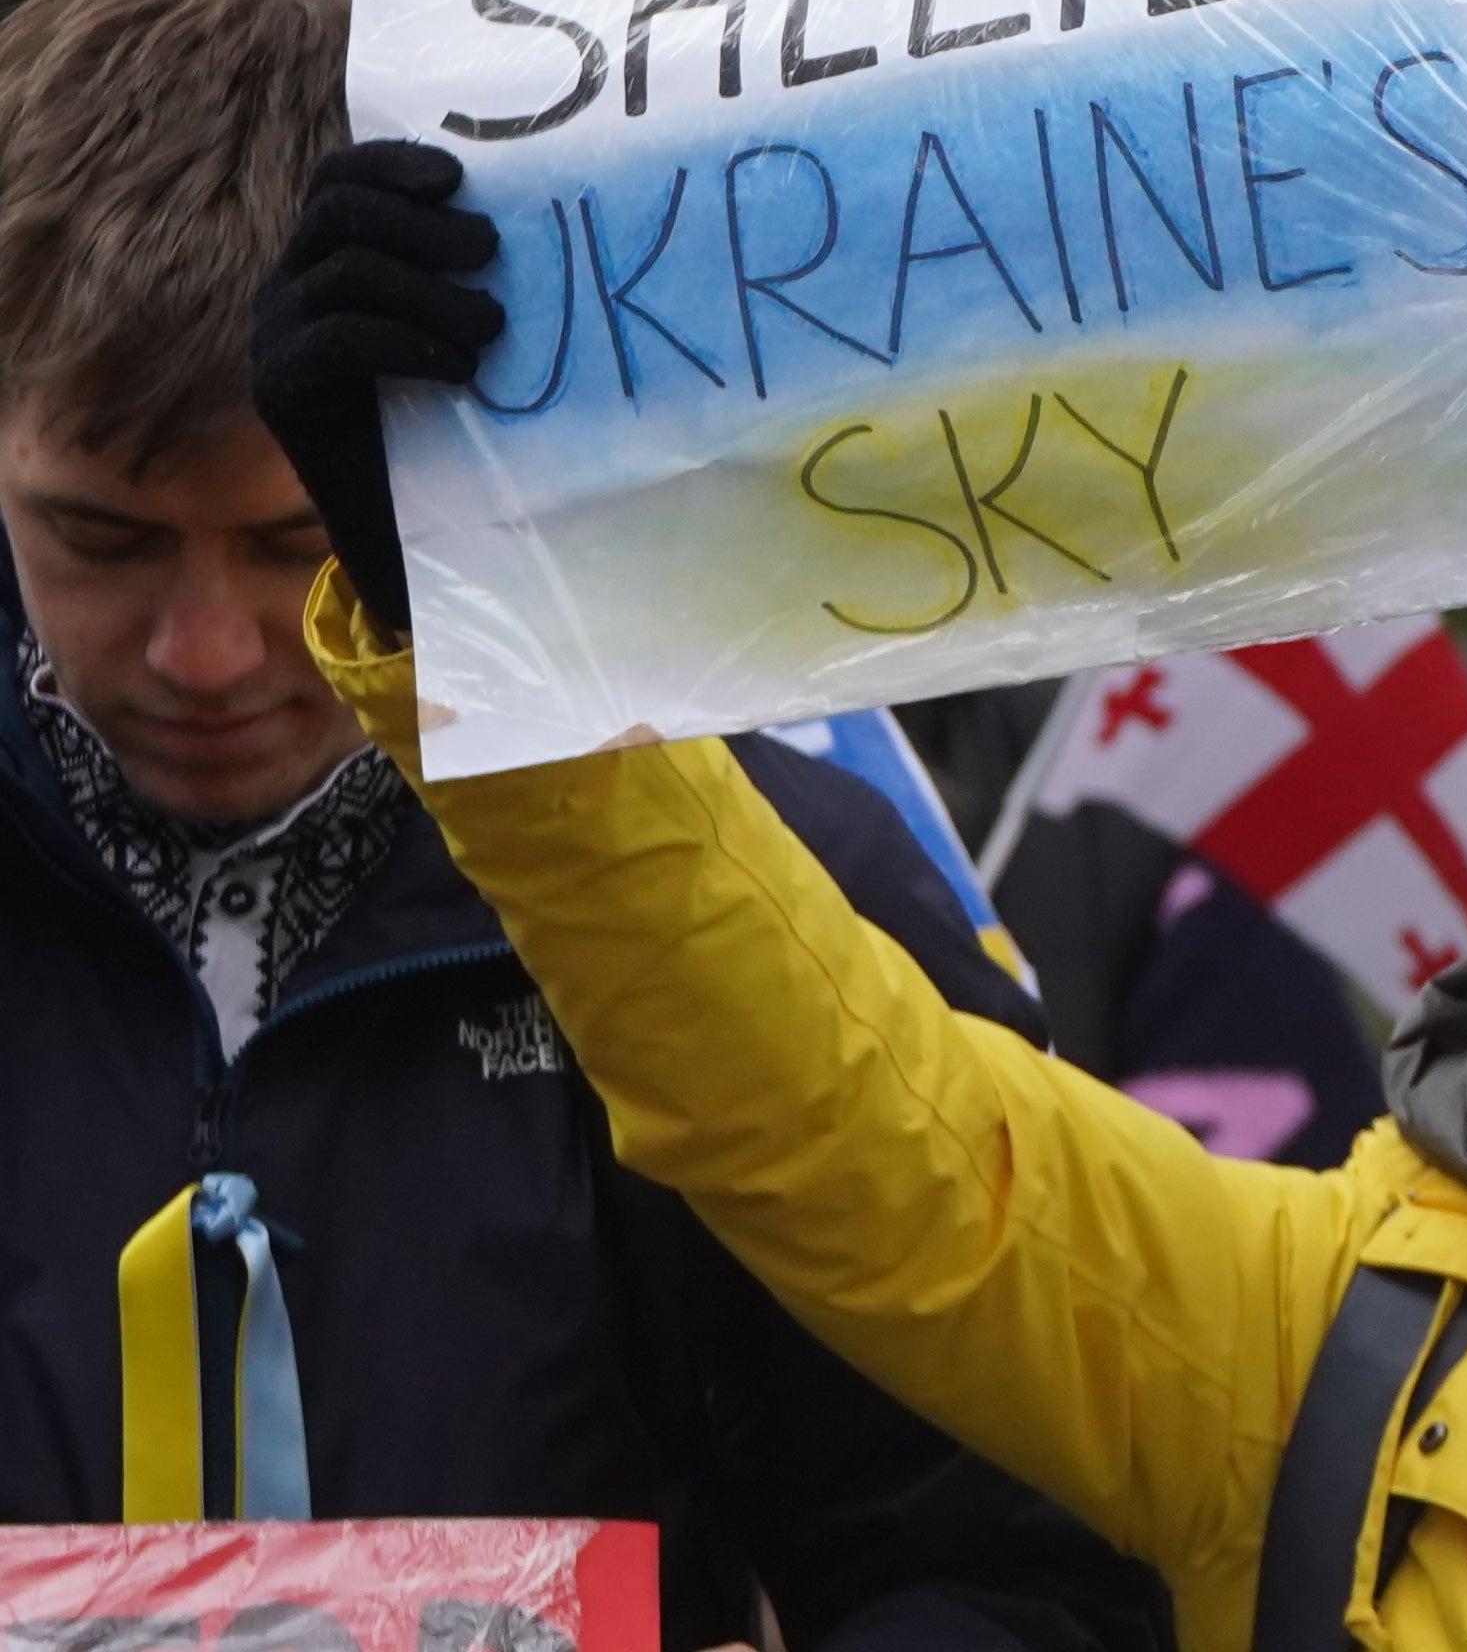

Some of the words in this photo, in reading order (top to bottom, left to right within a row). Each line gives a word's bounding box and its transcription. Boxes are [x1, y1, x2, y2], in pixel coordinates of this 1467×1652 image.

[801, 369, 1188, 633] SKY
[457, 1018, 556, 1054] NORTH
[480, 1045, 558, 1081] FACE
